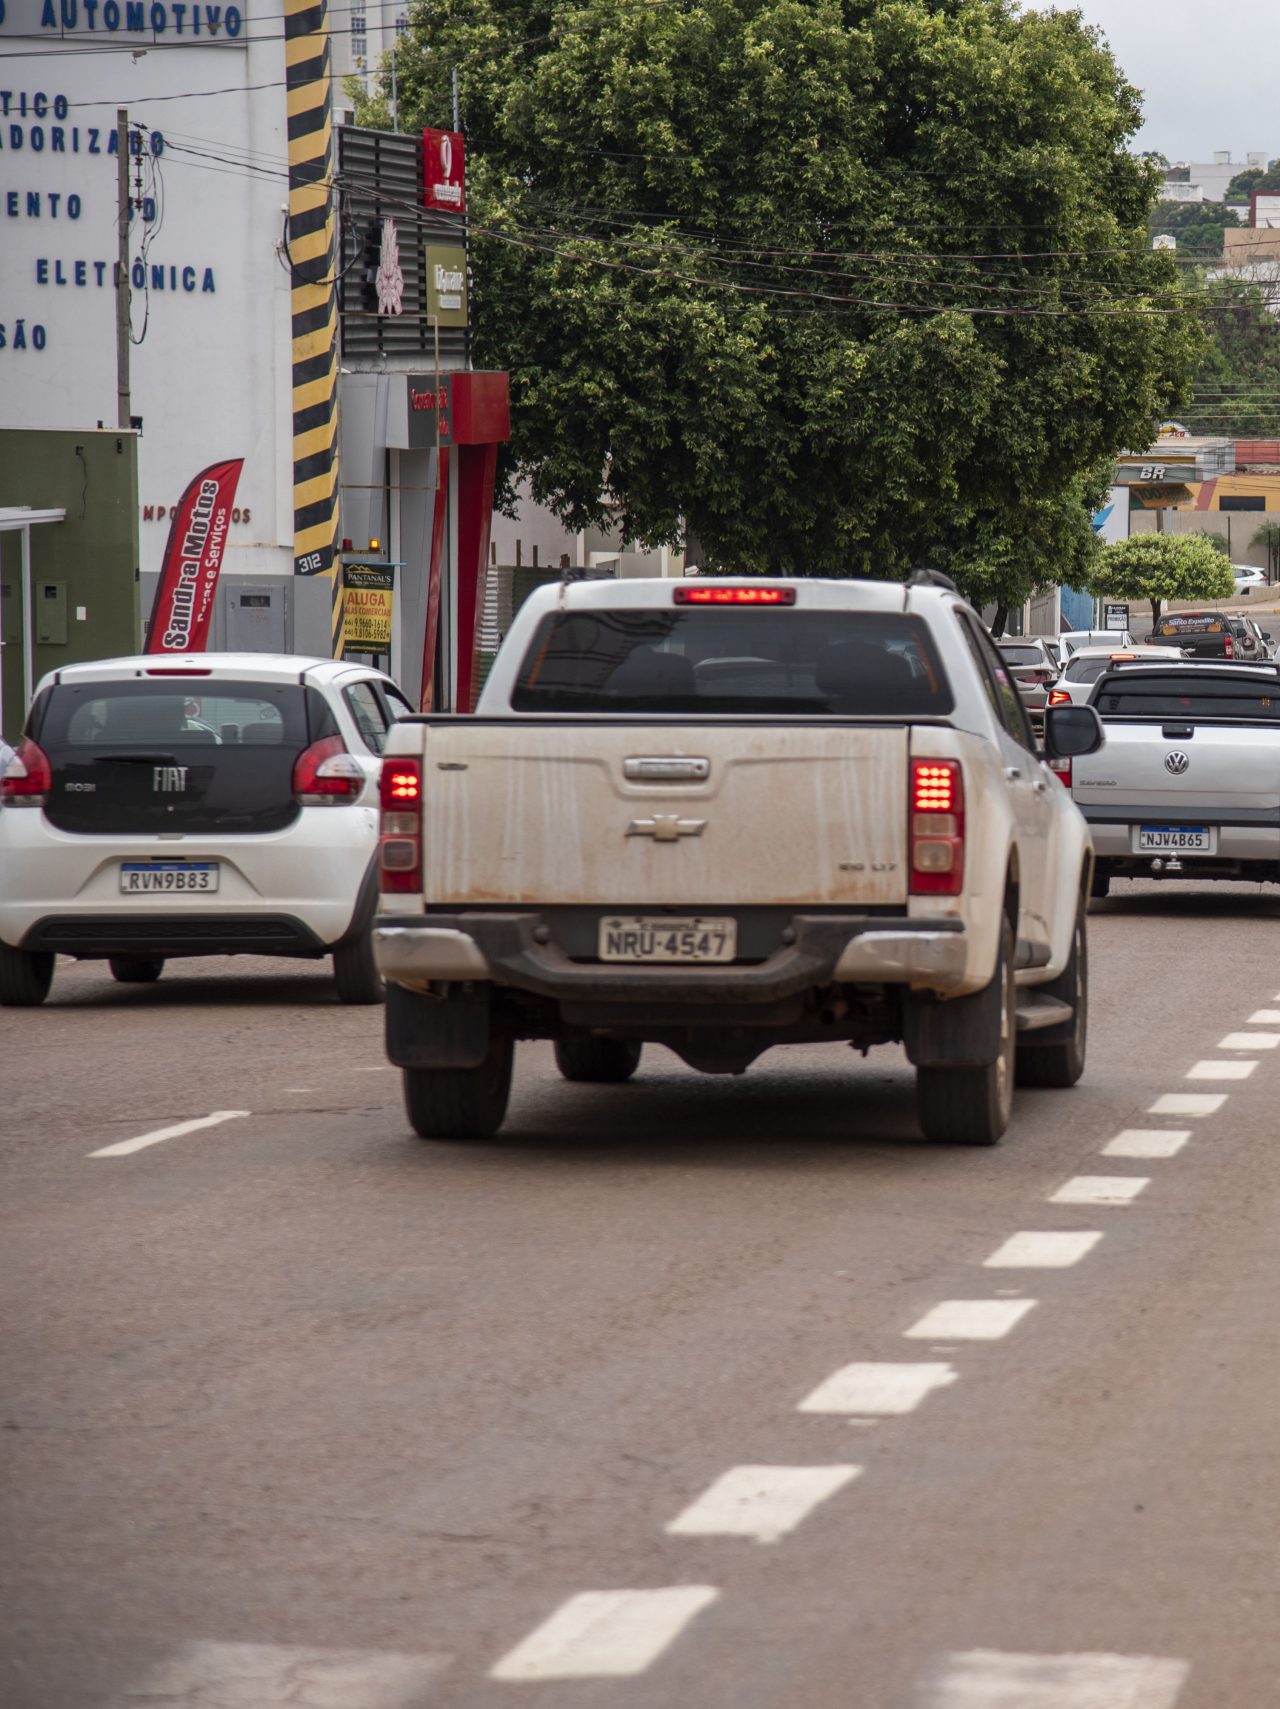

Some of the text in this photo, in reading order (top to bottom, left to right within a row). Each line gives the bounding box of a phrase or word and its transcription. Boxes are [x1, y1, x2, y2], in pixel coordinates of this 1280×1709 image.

[41, 0, 241, 37] AUTOMOTIVO
[0, 124, 163, 157] DORIZADO
[7, 192, 81, 219] ENTO
[37, 256, 216, 293] ELETÔNICA
[1140, 466, 1166, 480] BR
[204, 507, 226, 568] Serviços
[162, 479, 219, 649] Sandra Motos
[299, 553, 322, 573] 312
[348, 573, 391, 583] PANTANAL'S
[347, 591, 385, 606] ALUGA
[1168, 616, 1215, 626] Santo Expedito
[153, 767, 188, 791] FIAT
[1146, 833, 1203, 847] NJW4B65
[129, 872, 209, 889] RVN9B83
